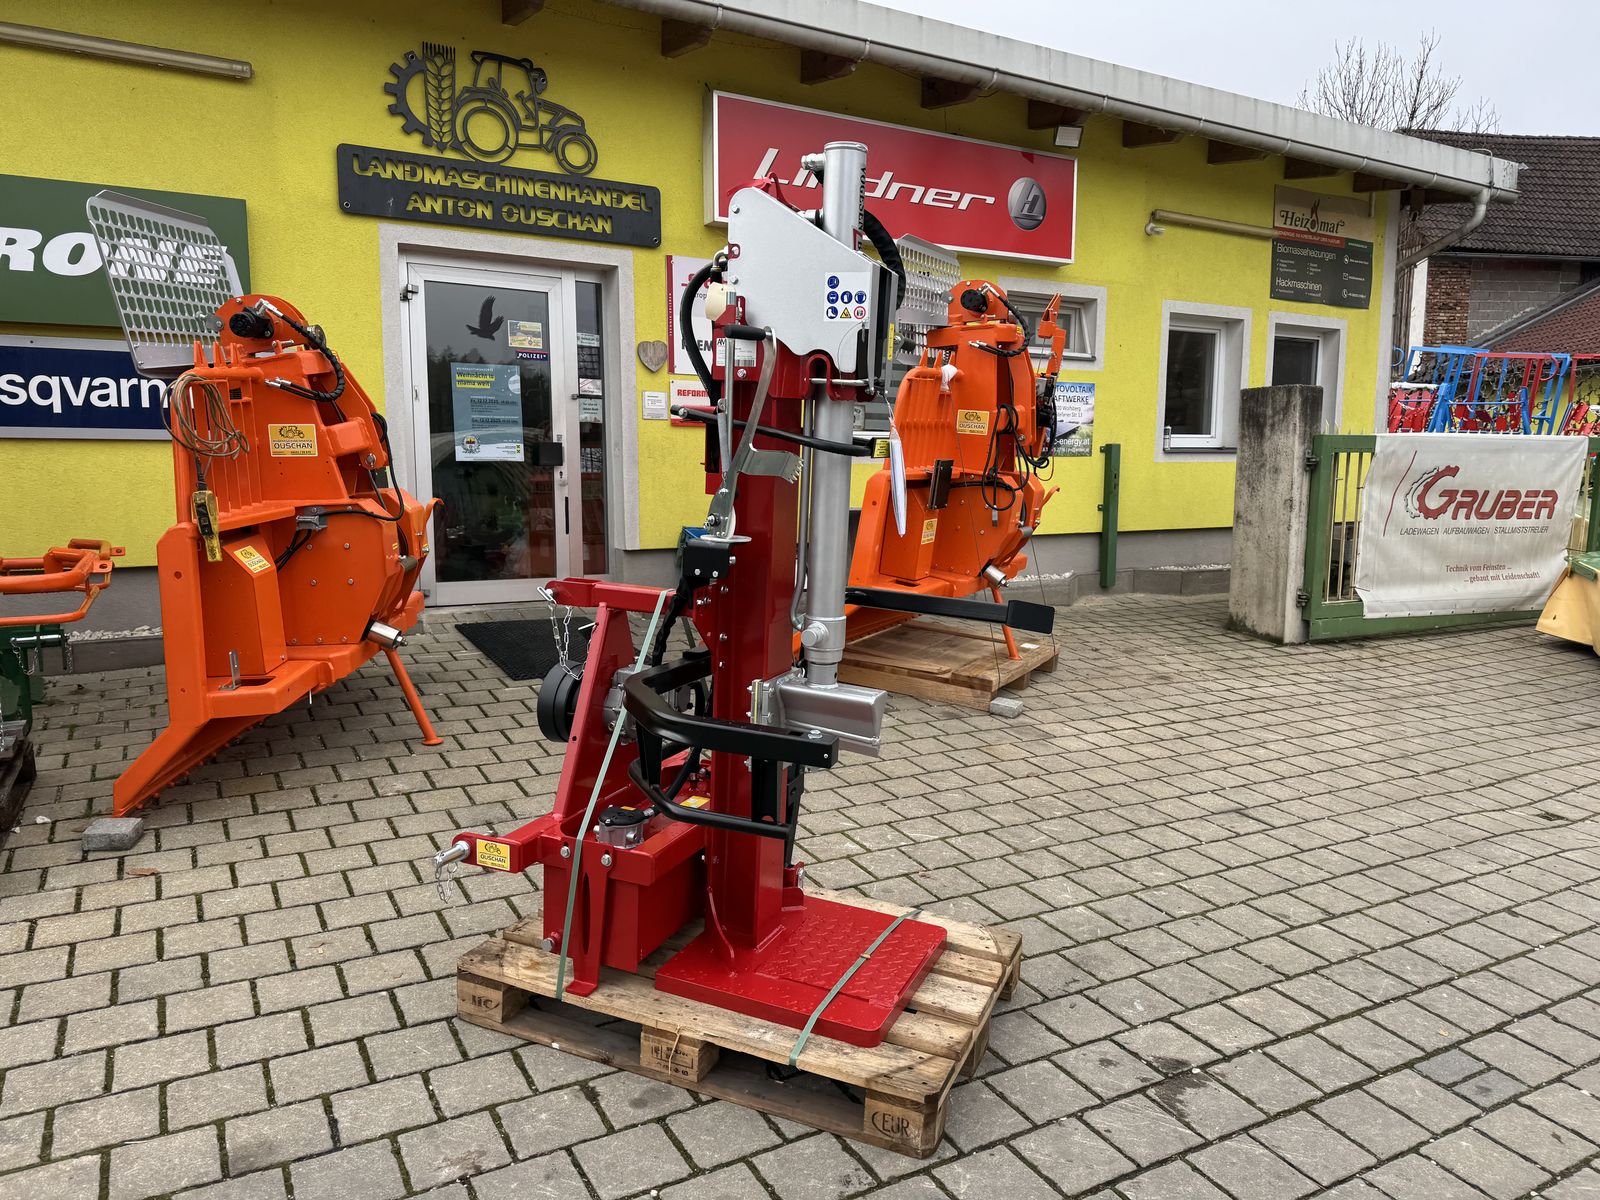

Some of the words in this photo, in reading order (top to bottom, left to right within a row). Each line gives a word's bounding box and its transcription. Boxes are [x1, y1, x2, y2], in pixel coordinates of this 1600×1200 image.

[352, 154, 652, 212] LANDMASCHINENHANDEL
[406, 192, 493, 220] ANTON
[501, 202, 612, 234] OUSCHAN
[1277, 243, 1336, 261] Biomasseheizungen
[1276, 277, 1322, 291] Hackmaschinen
[0, 373, 169, 414] sqvarn
[1056, 384, 1093, 394] TOVOLTAIK
[1054, 395, 1089, 403] AFTWERKE
[274, 442, 312, 450] OUSCHAN
[1417, 465, 1558, 520] GRUBER
[1400, 526, 1439, 536] LADEWAGEN
[1443, 525, 1490, 535] AUFBAUWAGEN
[1494, 525, 1549, 534] STALLMISTSTREUER
[1446, 564, 1469, 573] Technik
[1482, 563, 1506, 572] Feinsten
[1469, 574, 1490, 583] gebaut
[1490, 573, 1500, 581] mit
[1501, 571, 1540, 581] Leidenschaft!
[480, 853, 506, 863] OUSCHAN
[882, 1112, 910, 1138] EUR
